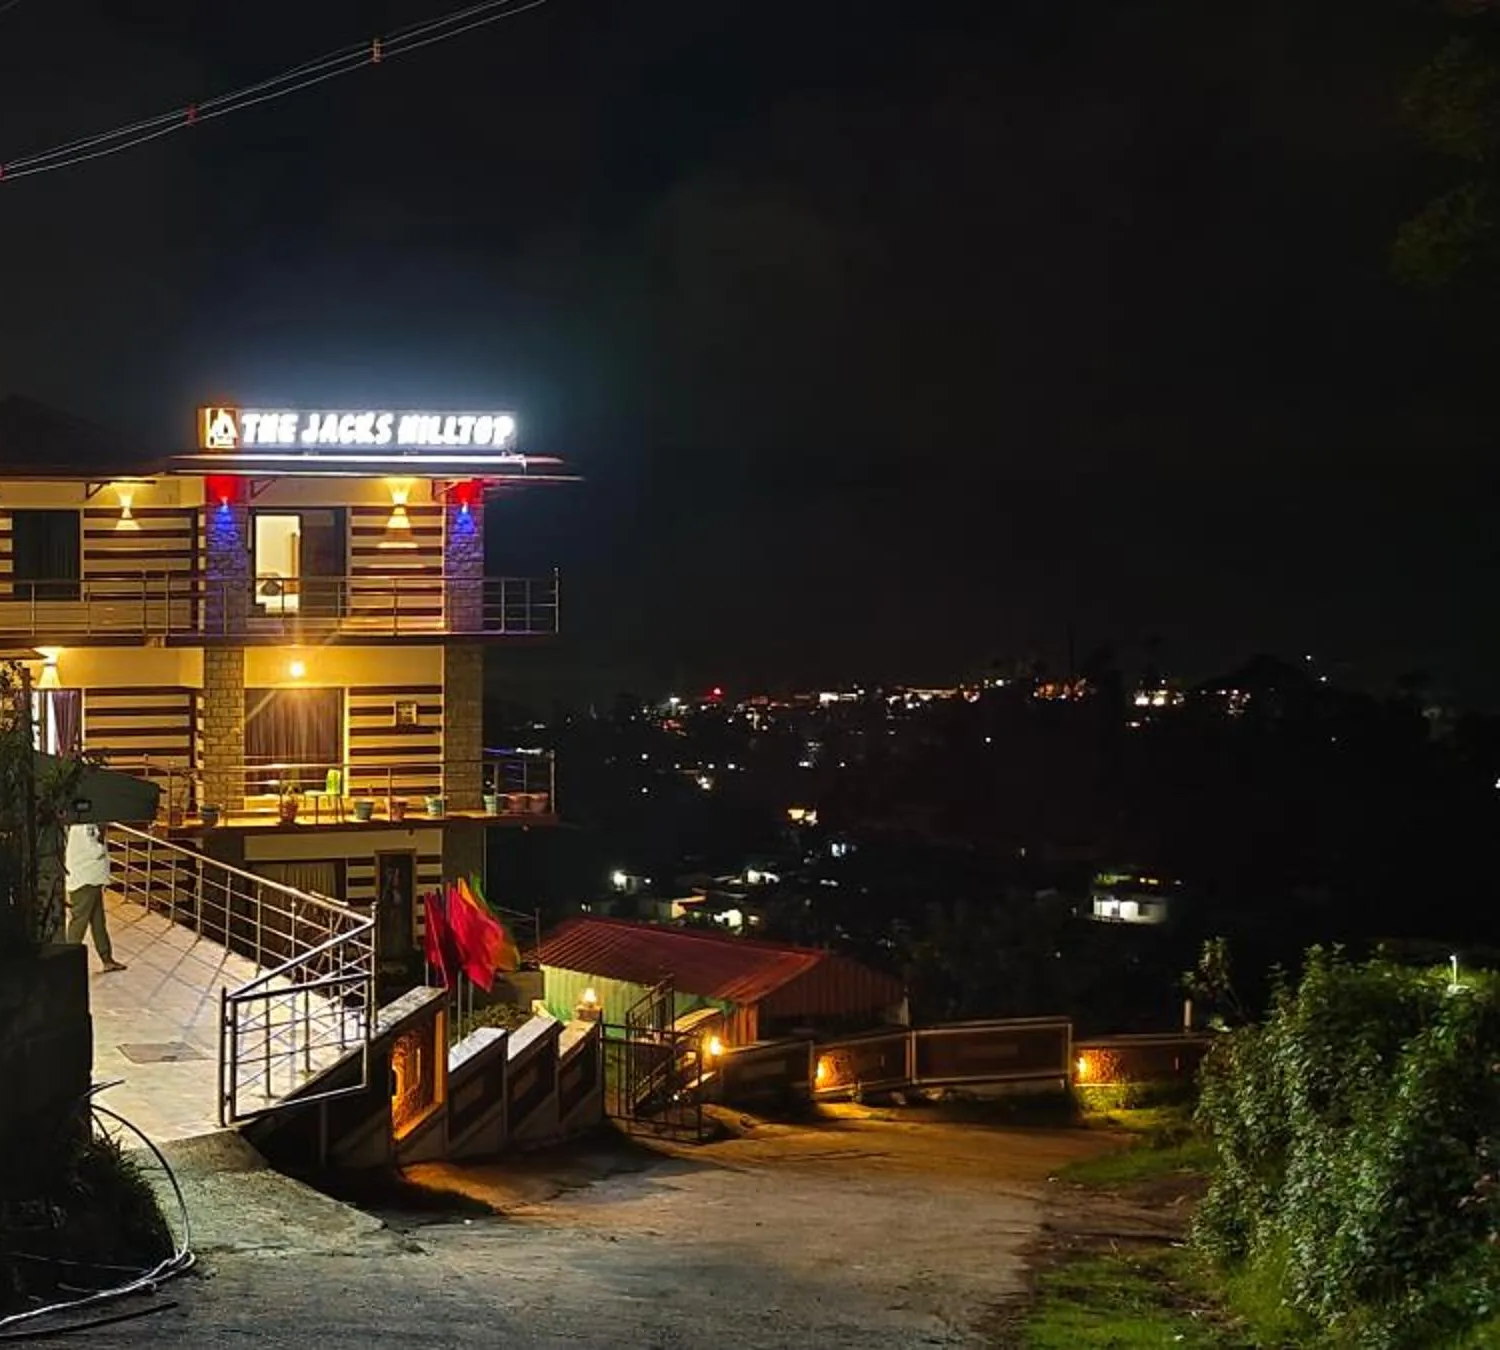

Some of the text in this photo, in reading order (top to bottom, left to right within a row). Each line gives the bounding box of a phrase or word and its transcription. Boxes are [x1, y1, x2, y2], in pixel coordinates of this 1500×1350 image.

[241, 412, 515, 445] THE JACKS HILLTOP
